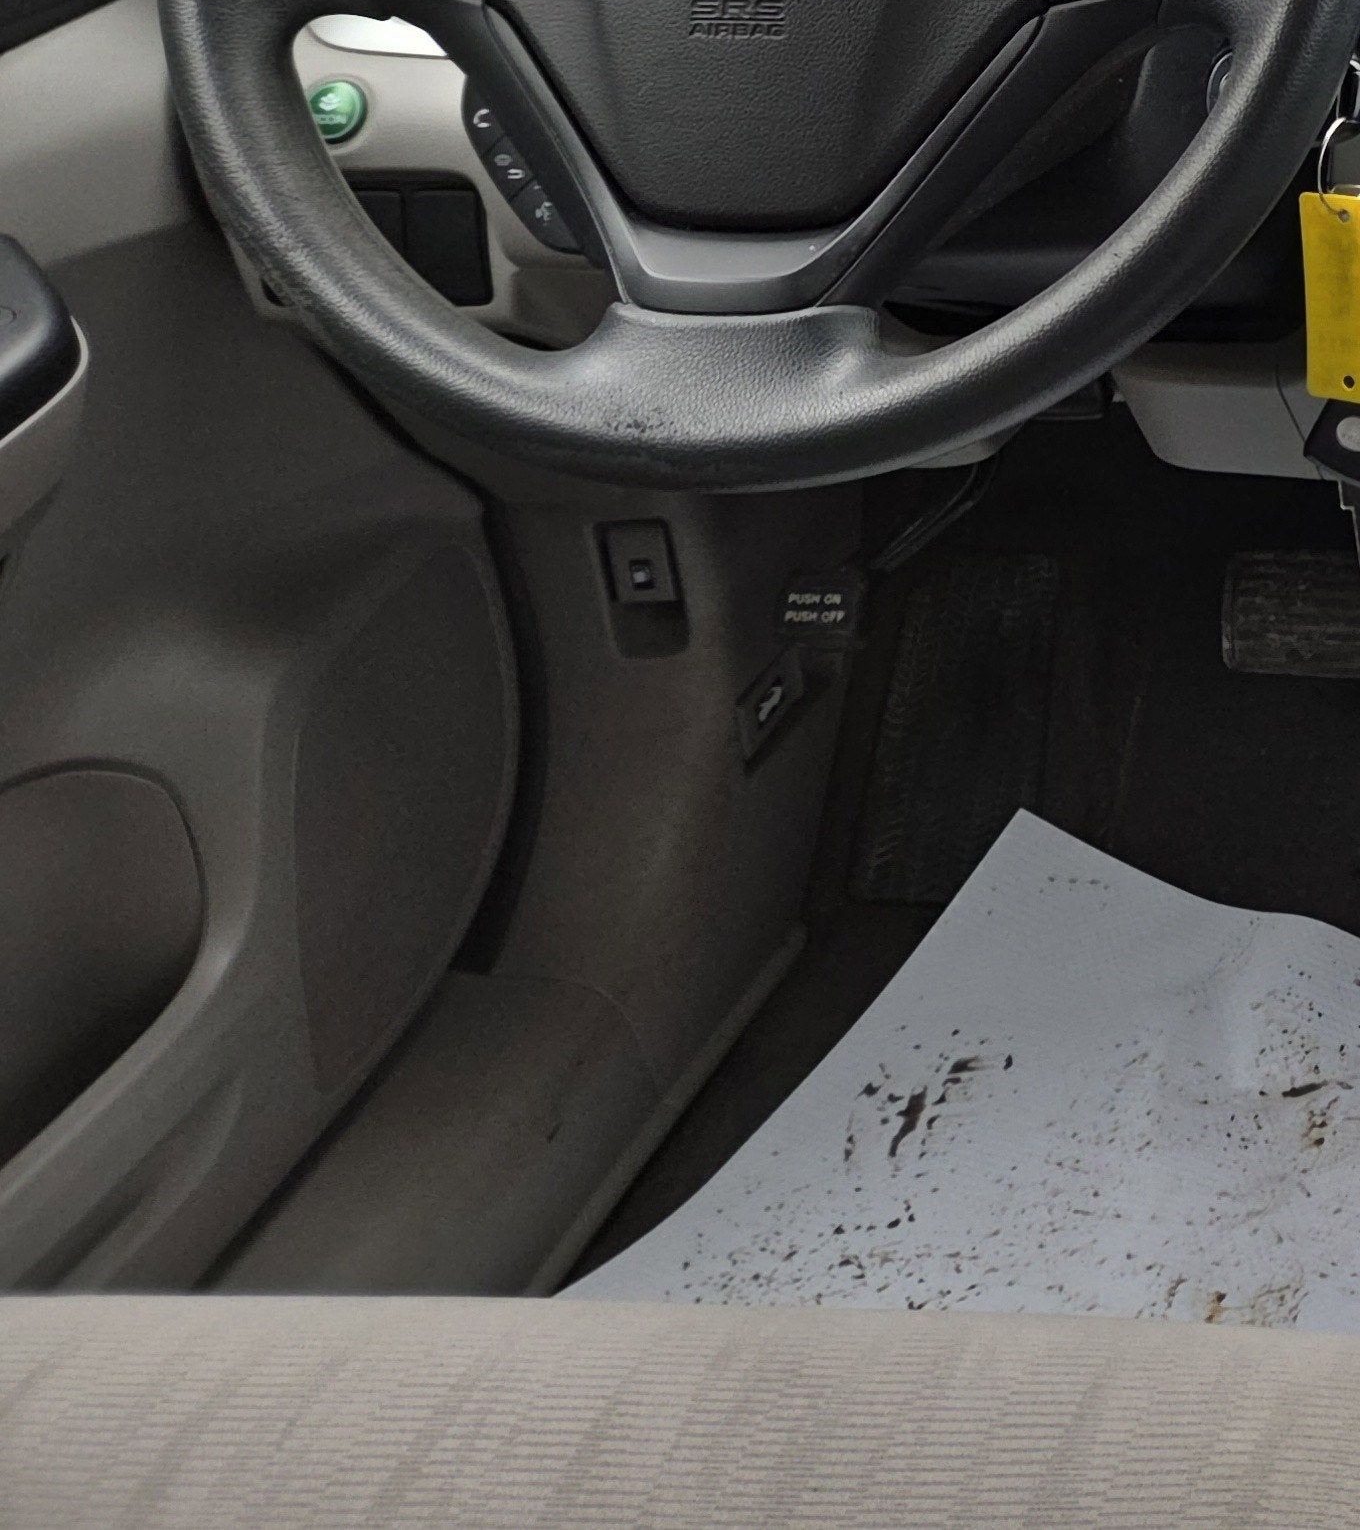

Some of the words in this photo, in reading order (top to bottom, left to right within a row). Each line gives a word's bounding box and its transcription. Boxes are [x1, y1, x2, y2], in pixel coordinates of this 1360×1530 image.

[688, 22, 788, 39] AIRBAG
[788, 592, 821, 604] PUSH
[823, 592, 842, 605] ON
[784, 610, 818, 622] PUSH
[819, 610, 846, 623] OFF
